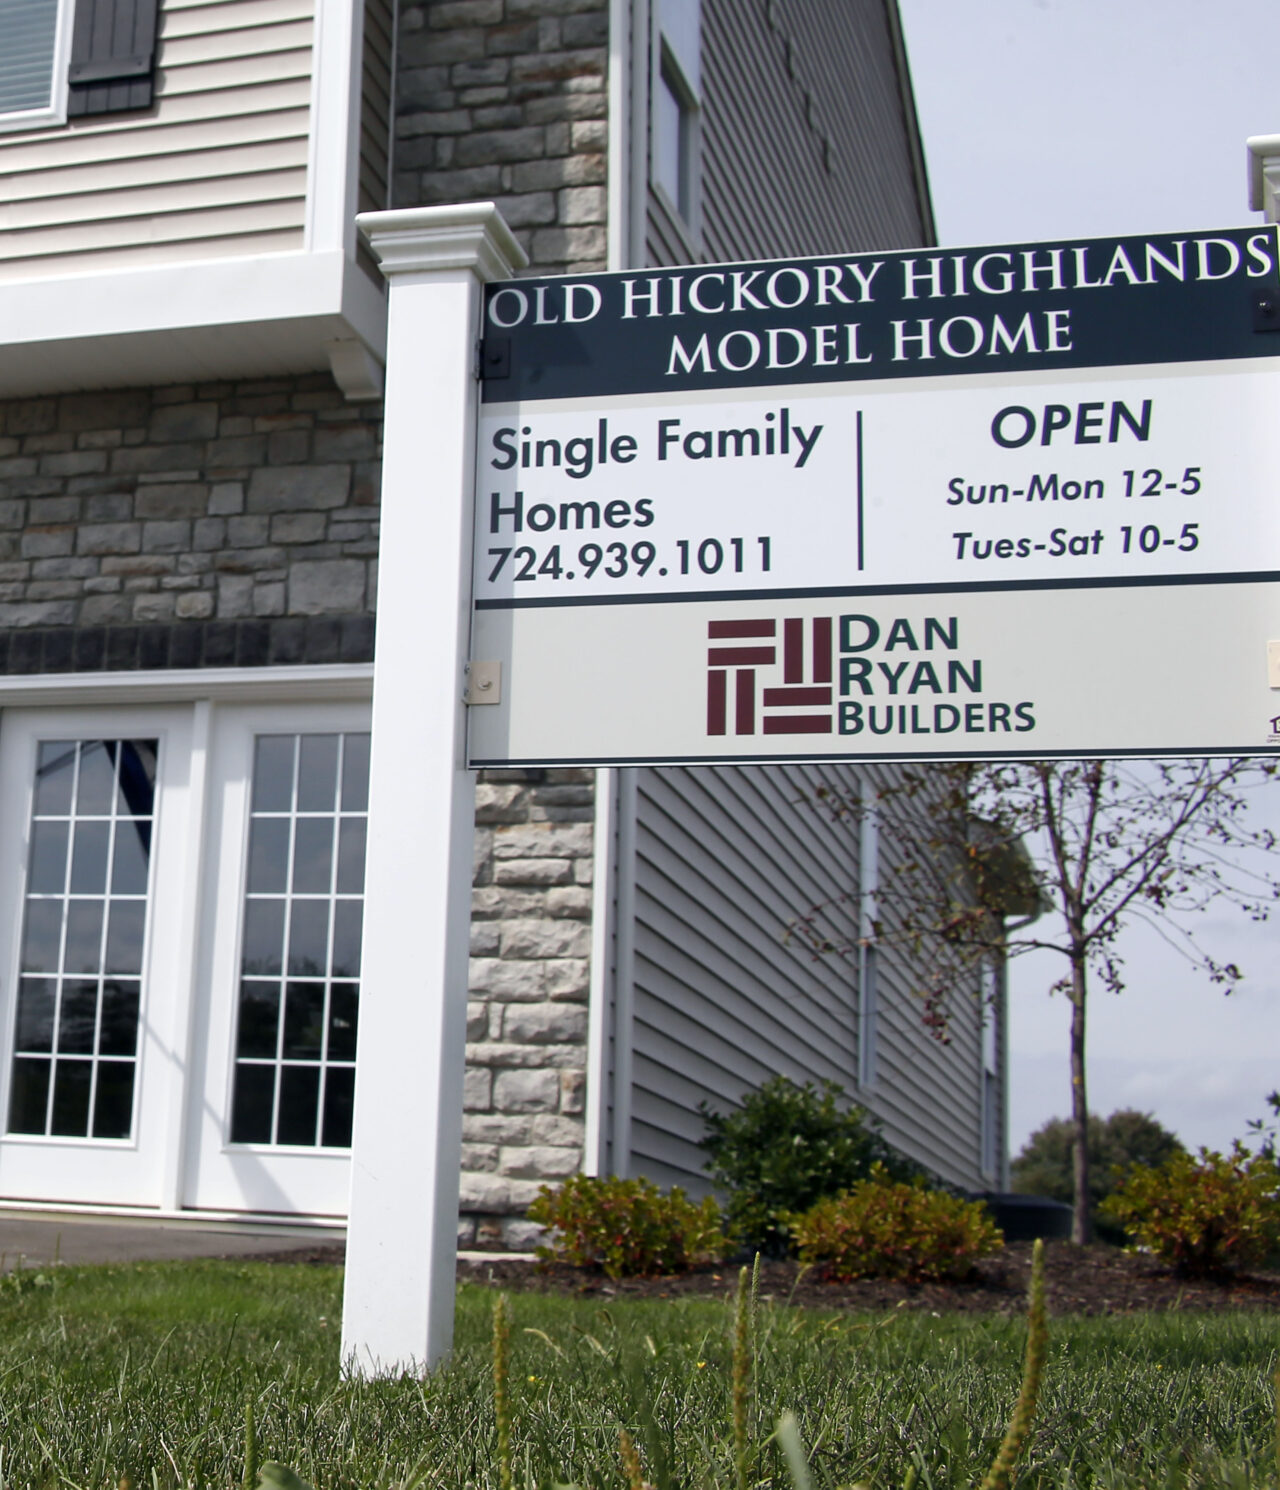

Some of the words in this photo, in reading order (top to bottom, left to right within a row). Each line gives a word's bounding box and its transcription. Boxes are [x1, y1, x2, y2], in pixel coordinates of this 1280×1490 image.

[487, 282, 603, 328] OLD
[621, 260, 886, 319] HICKORY
[900, 234, 1273, 300] HIGHLANDS
[664, 323, 873, 376] MODEL
[890, 309, 1073, 361] HOME
[491, 418, 638, 479] Single
[658, 407, 824, 468] Family
[990, 399, 1154, 449] OPEN
[946, 474, 1105, 506] Sun-Mon
[1122, 467, 1202, 498] 12-5
[489, 491, 655, 534] Homes
[487, 536, 772, 583] 724.939.1011
[952, 528, 1104, 560] Tues-Sat
[1120, 523, 1200, 554] 10-5
[838, 614, 959, 653] DAN
[838, 657, 983, 696] RYAN
[838, 701, 1037, 736] BUILDERS
